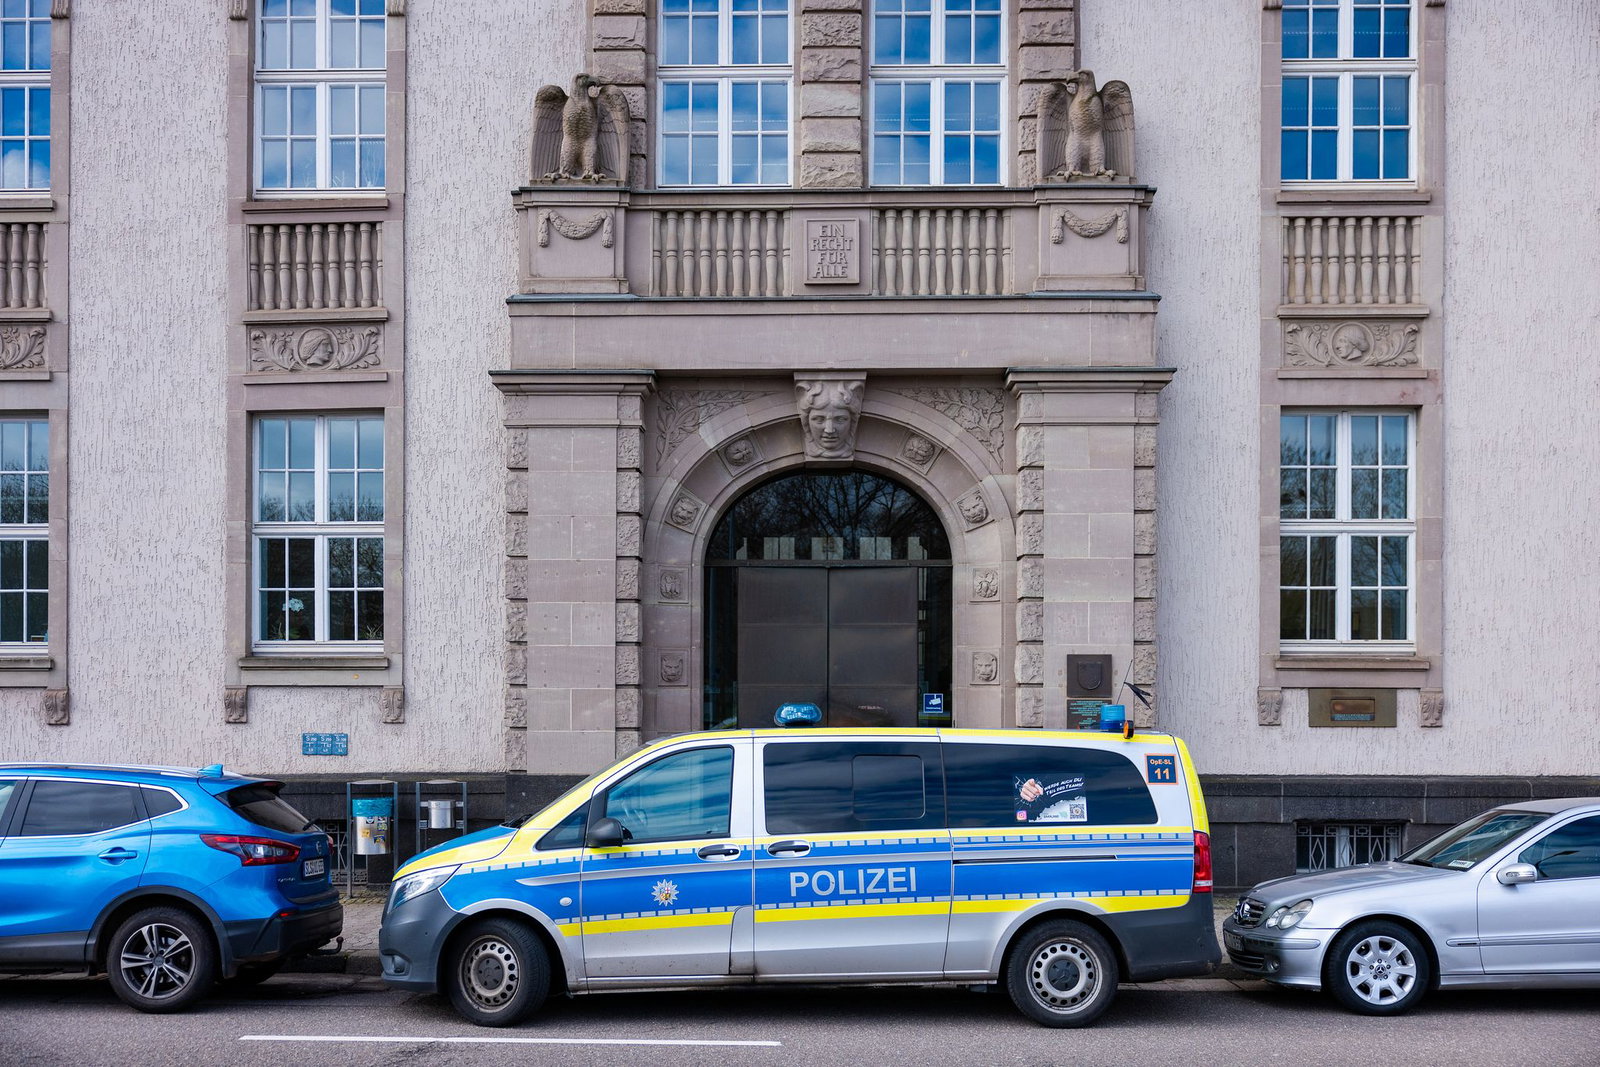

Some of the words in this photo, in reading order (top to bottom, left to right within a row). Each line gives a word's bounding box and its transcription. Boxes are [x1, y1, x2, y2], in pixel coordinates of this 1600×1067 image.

[818, 224, 845, 238] EIN
[810, 238, 853, 251] RECHT
[812, 265, 848, 279] ALLE
[1154, 768, 1170, 780] 11
[789, 866, 917, 897] POLIZEI
